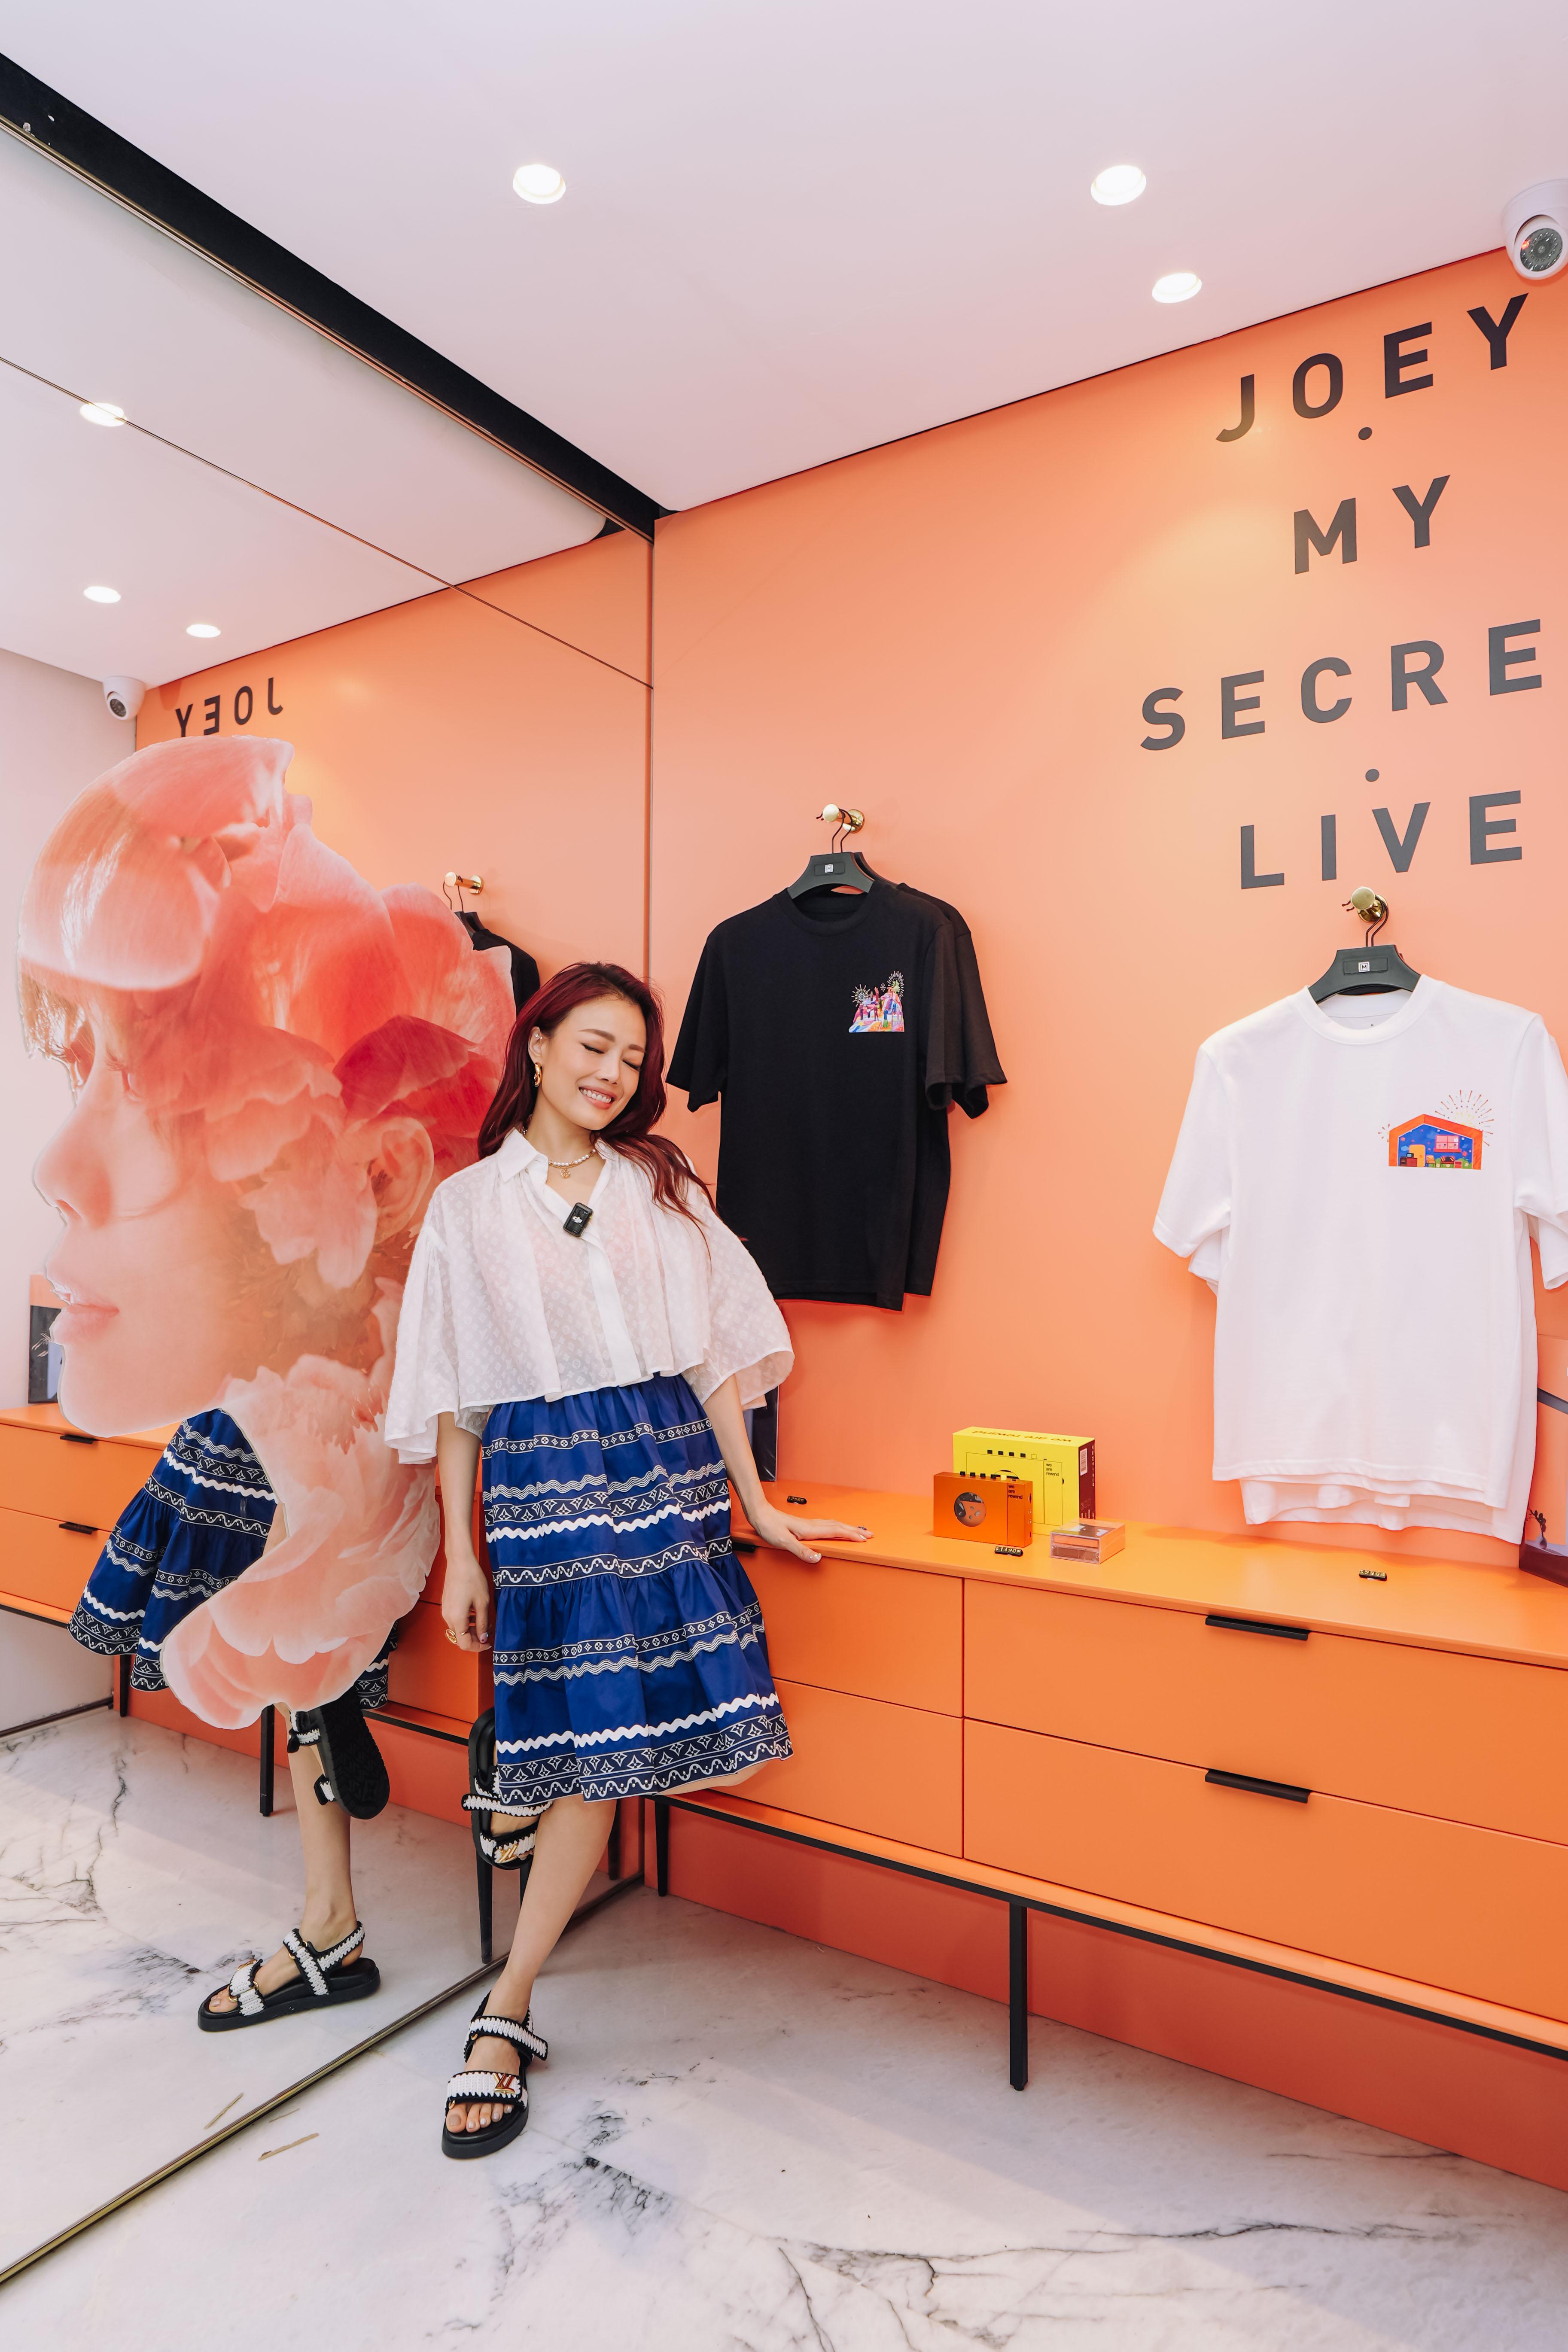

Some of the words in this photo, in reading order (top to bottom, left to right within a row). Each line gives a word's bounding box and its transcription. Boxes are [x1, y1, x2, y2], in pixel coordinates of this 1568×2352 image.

[1215, 293, 1529, 442] JOEY
[1294, 475, 1450, 574] MY
[1140, 619, 1542, 751] SECRE
[1241, 790, 1522, 889] LIVE
